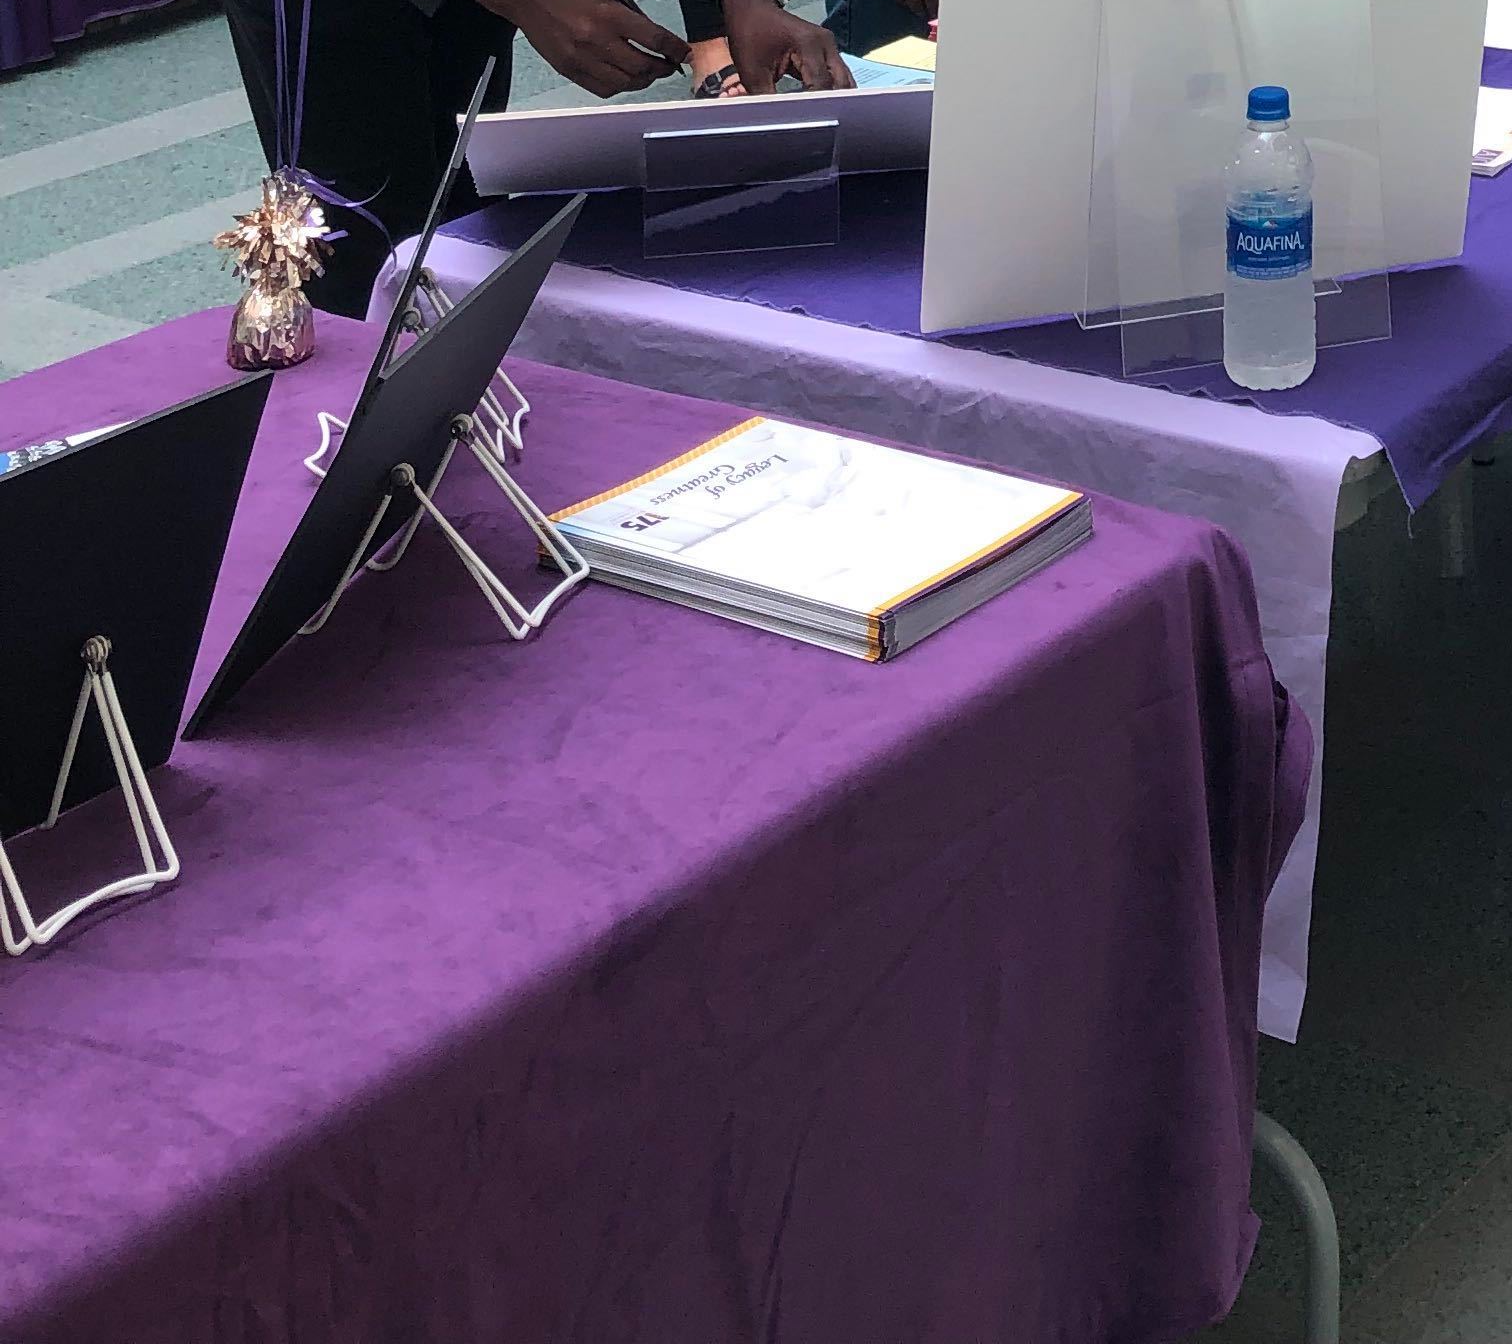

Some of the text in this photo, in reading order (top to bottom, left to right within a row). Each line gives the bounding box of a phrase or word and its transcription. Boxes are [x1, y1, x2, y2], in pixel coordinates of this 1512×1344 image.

[1236, 231, 1304, 255] AQUAFINA
[650, 464, 736, 506] Greatness
[705, 453, 789, 500] Legacy of
[620, 511, 670, 532] 175
